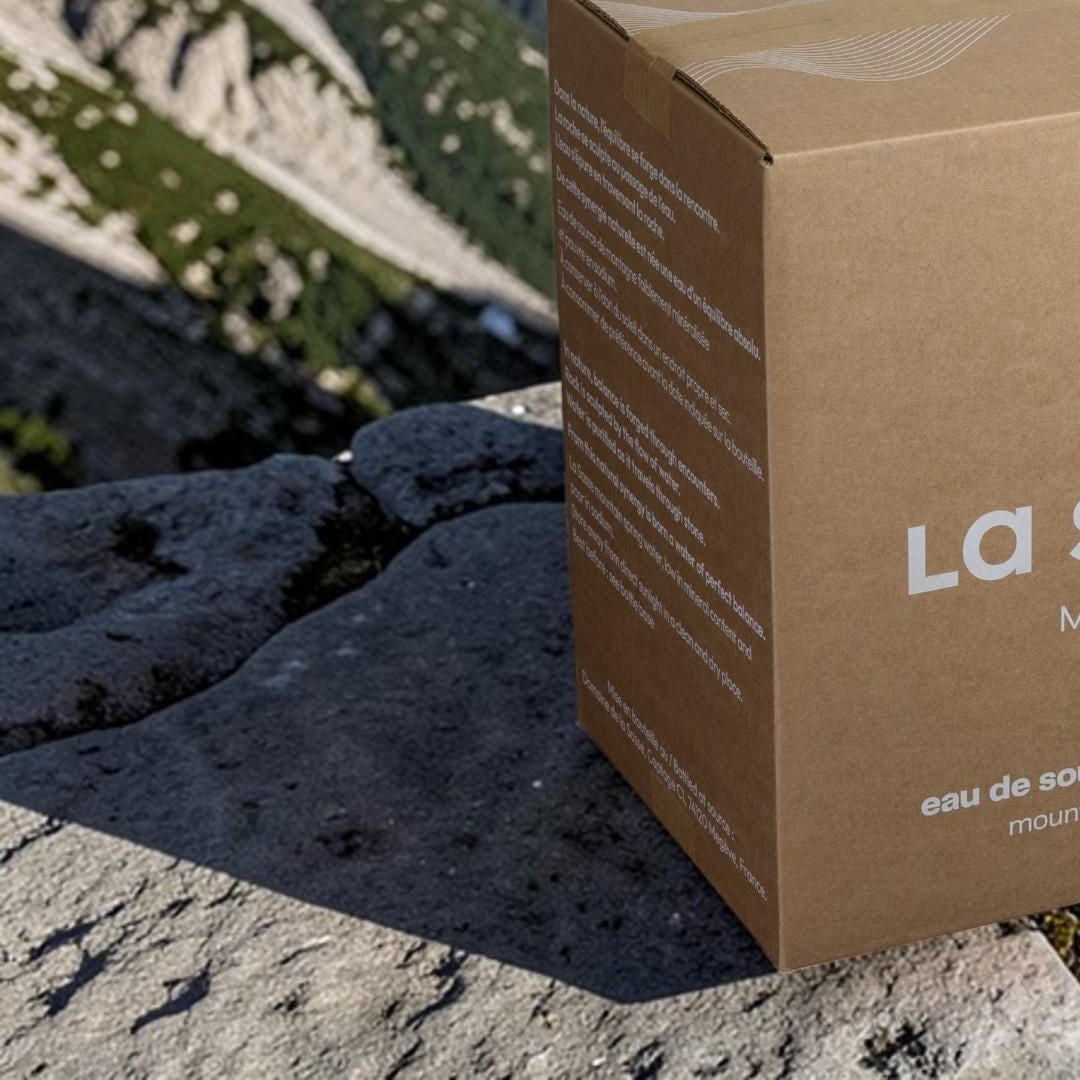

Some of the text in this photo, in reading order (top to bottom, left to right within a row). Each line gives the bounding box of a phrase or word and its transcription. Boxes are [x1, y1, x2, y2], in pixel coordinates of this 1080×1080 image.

[555, 105, 562, 124] La
[581, 132, 588, 147] se
[612, 159, 620, 175] au
[649, 187, 658, 208] de
[557, 165, 565, 185] De
[570, 93, 577, 111] la
[632, 149, 639, 164] se
[676, 182, 682, 201] la
[564, 341, 570, 359] In
[594, 371, 619, 408] balance
[620, 397, 625, 415] is
[626, 403, 648, 438] forged
[650, 428, 677, 466] through
[565, 366, 580, 392] Rock
[581, 382, 586, 399] is
[586, 392, 613, 426] sculpted
[613, 415, 622, 439] by
[623, 426, 634, 447] the
[635, 437, 648, 463] flow
[650, 456, 658, 473] of
[586, 411, 591, 428] is
[617, 447, 625, 463] as
[626, 452, 631, 469] it
[568, 423, 584, 451] From
[585, 441, 596, 463] this
[597, 456, 619, 488] natural
[620, 481, 645, 518] synergy
[646, 504, 651, 521] is
[652, 510, 668, 539] born
[675, 538, 695, 568] water
[697, 561, 705, 577] of
[706, 570, 732, 606] perfect
[907, 505, 1033, 596] La
[920, 782, 980, 817] eau
[989, 775, 1031, 802] de
